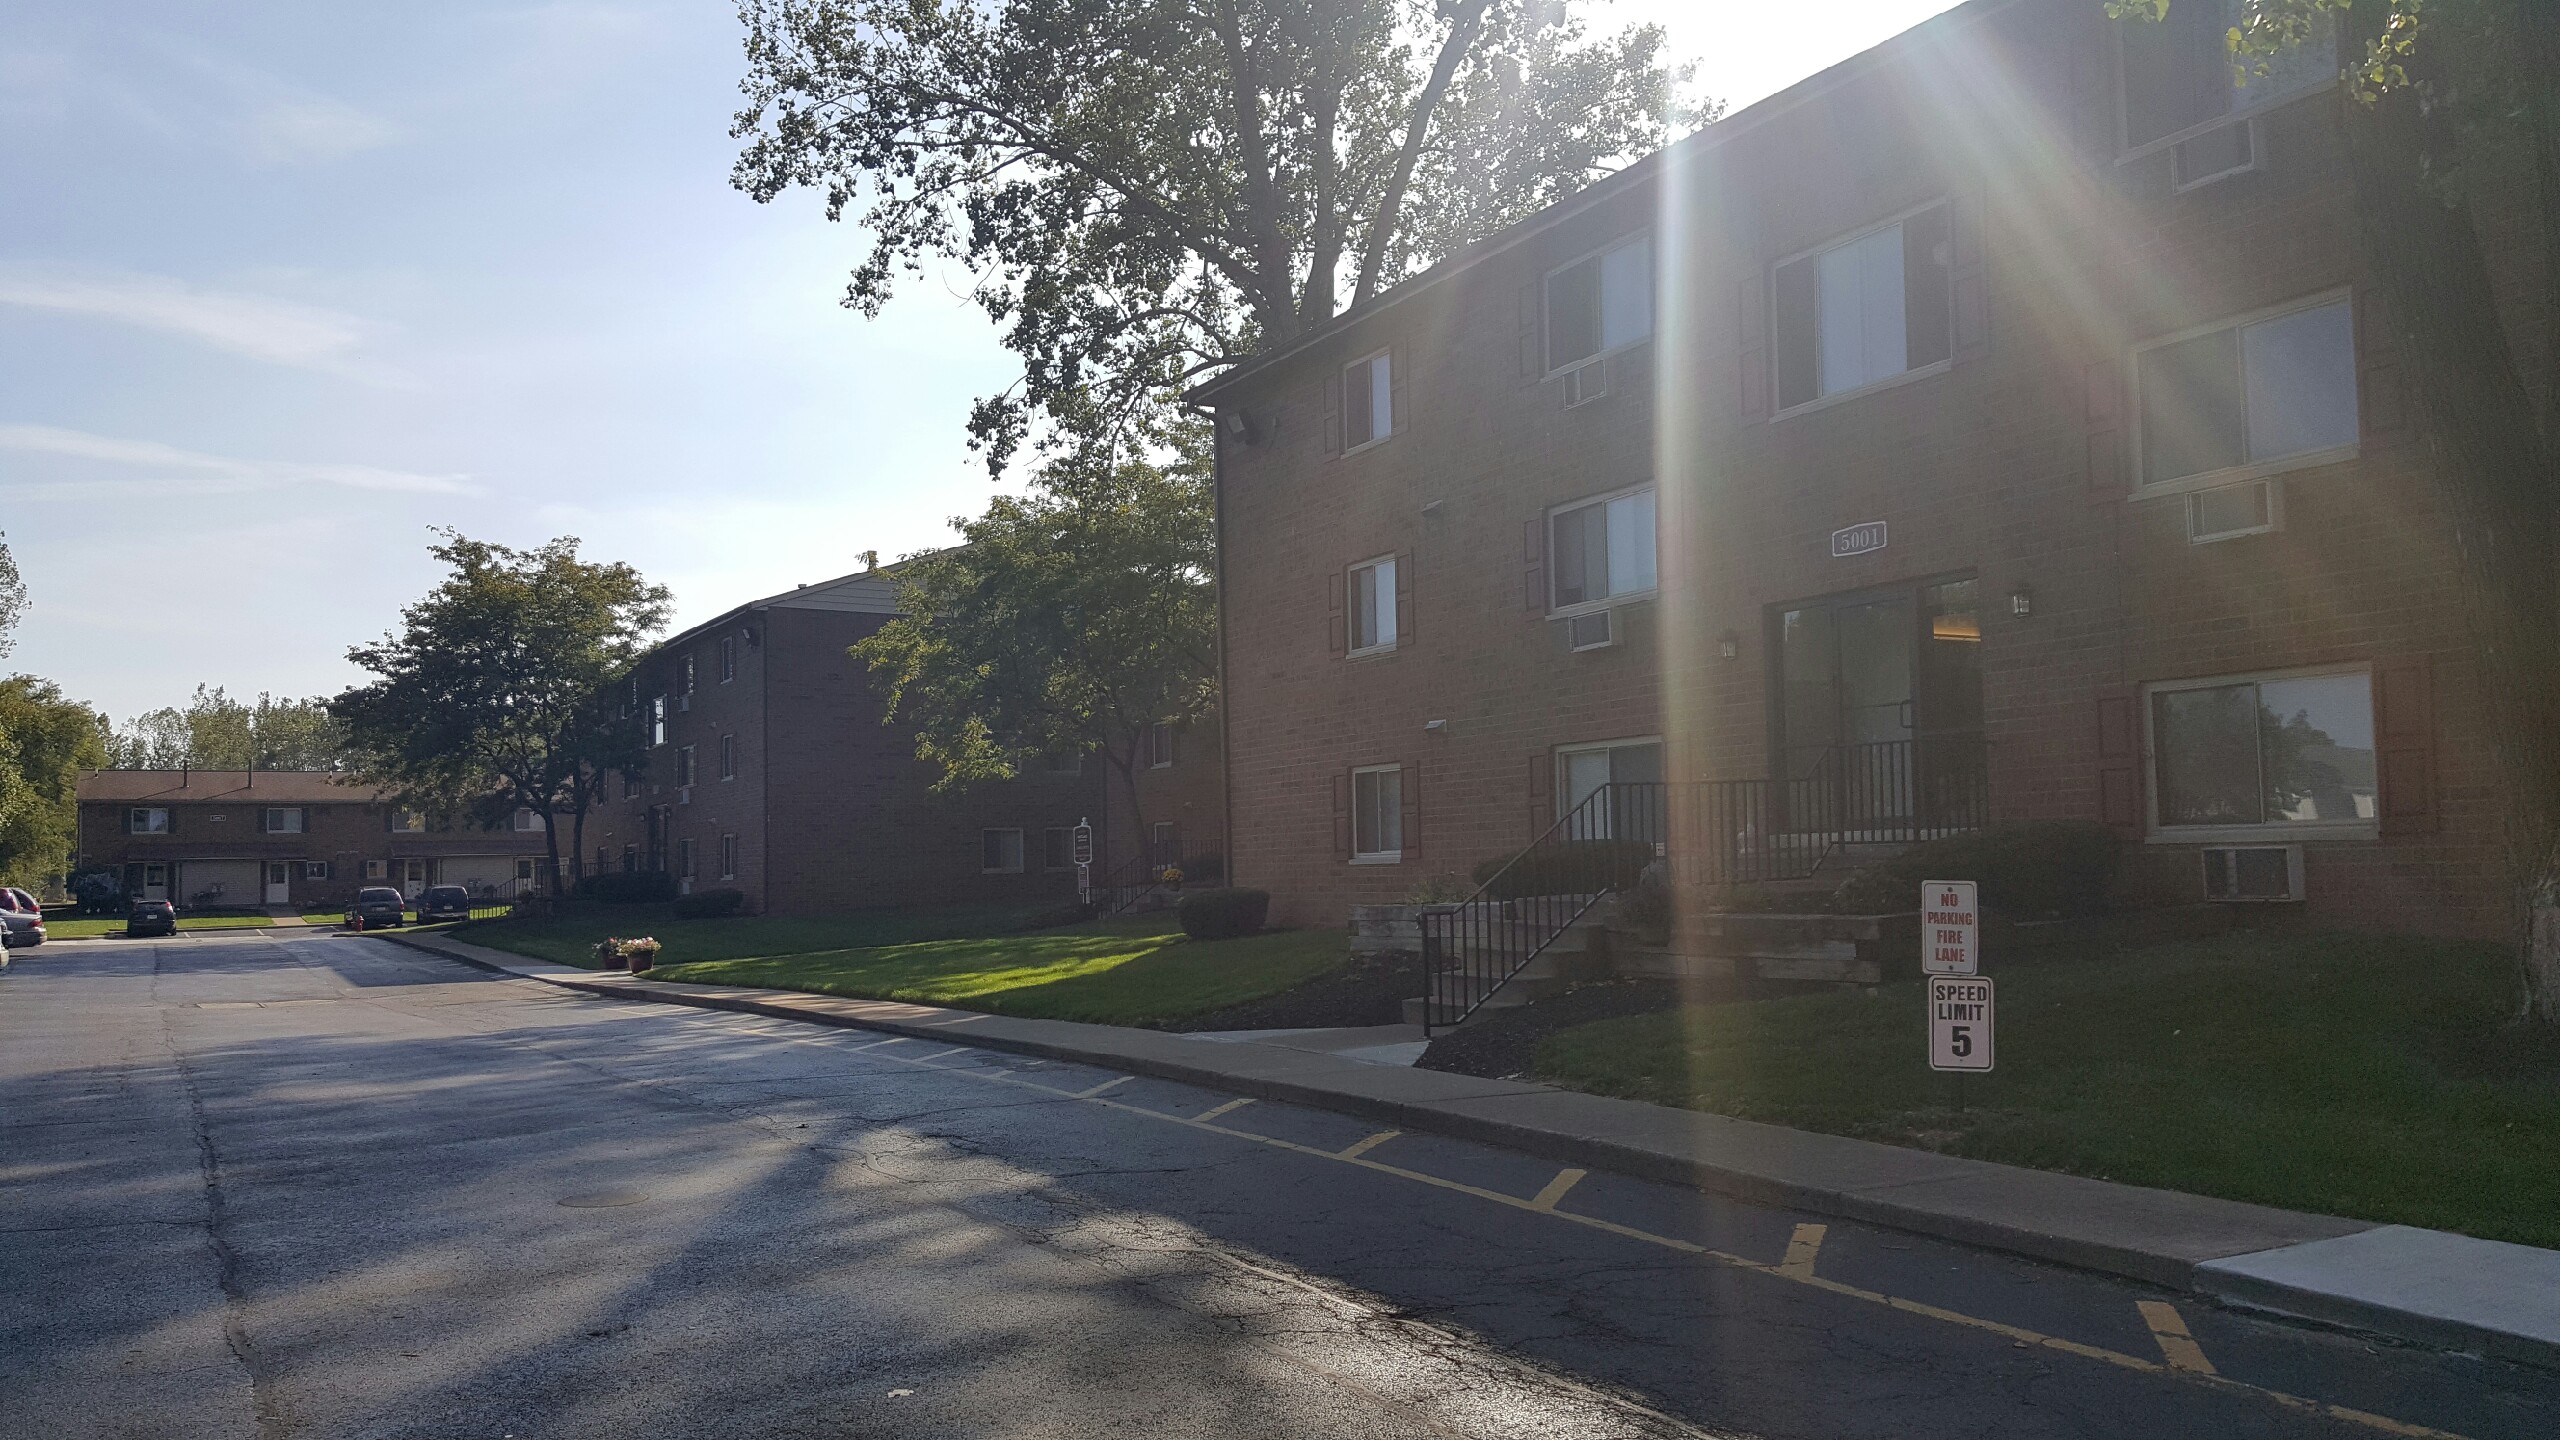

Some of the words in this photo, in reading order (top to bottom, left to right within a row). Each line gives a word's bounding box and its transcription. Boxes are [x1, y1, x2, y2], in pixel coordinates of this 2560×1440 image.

[1841, 528, 1878, 551] 5001
[1941, 893, 1959, 907] NO
[1928, 911, 1973, 926] PARKING
[1936, 930, 1963, 944] FIRE
[1935, 949, 1965, 963] LANE
[1936, 985, 1987, 1001] SPEED
[1939, 1004, 1984, 1021] LIMIT
[1952, 1026, 1972, 1057] 5
